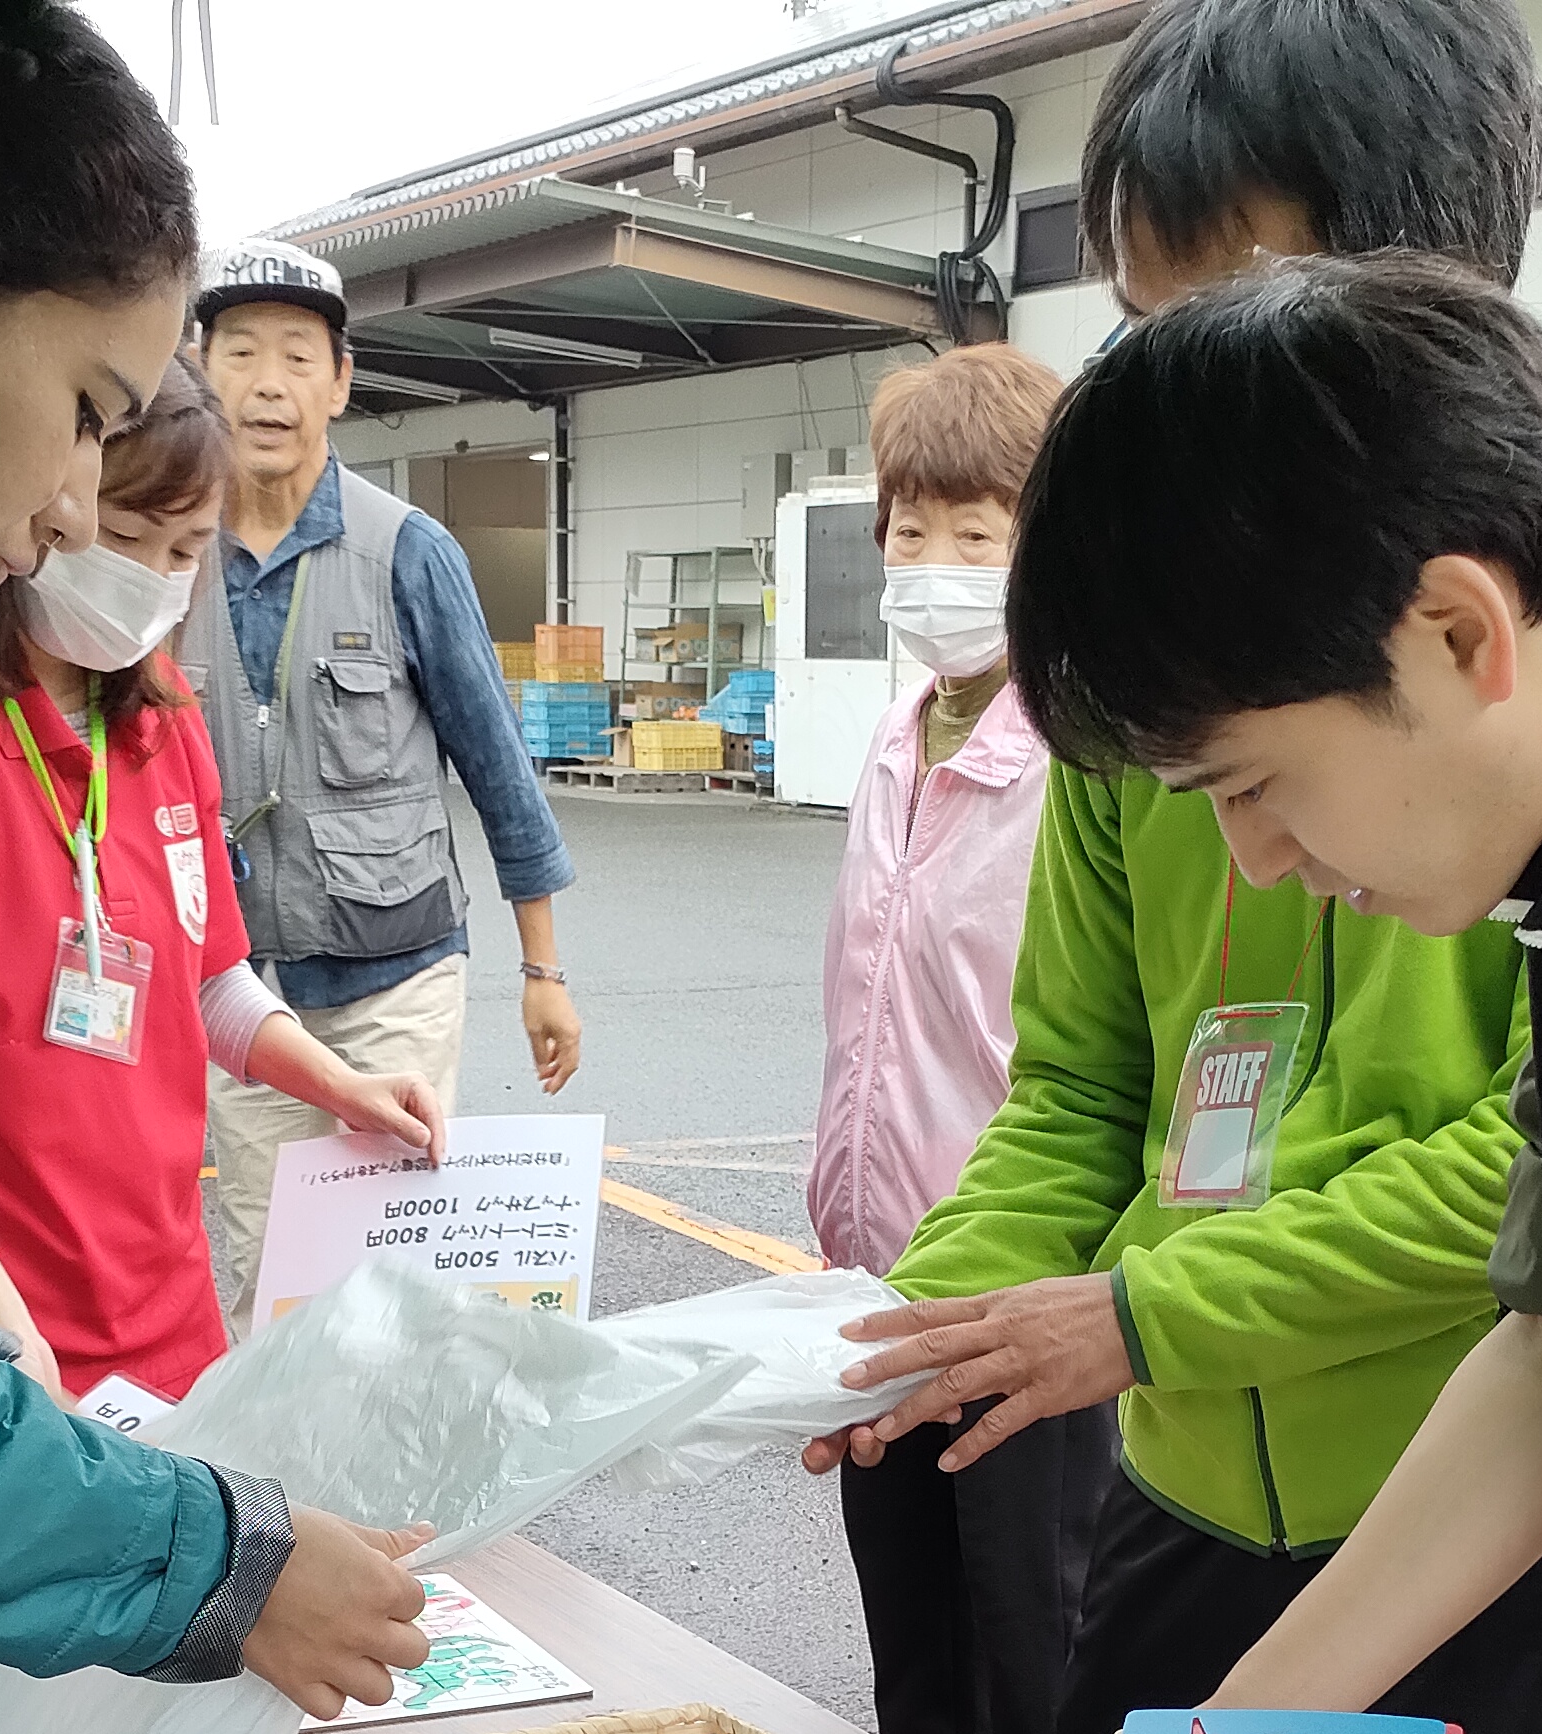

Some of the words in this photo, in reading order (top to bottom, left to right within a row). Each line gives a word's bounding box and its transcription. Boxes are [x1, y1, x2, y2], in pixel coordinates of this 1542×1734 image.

[1197, 1051, 1268, 1106] STAFF
[385, 1197, 458, 1219] 1000円
[366, 1226, 429, 1247] 800円
[434, 1250, 499, 1270] 500円
